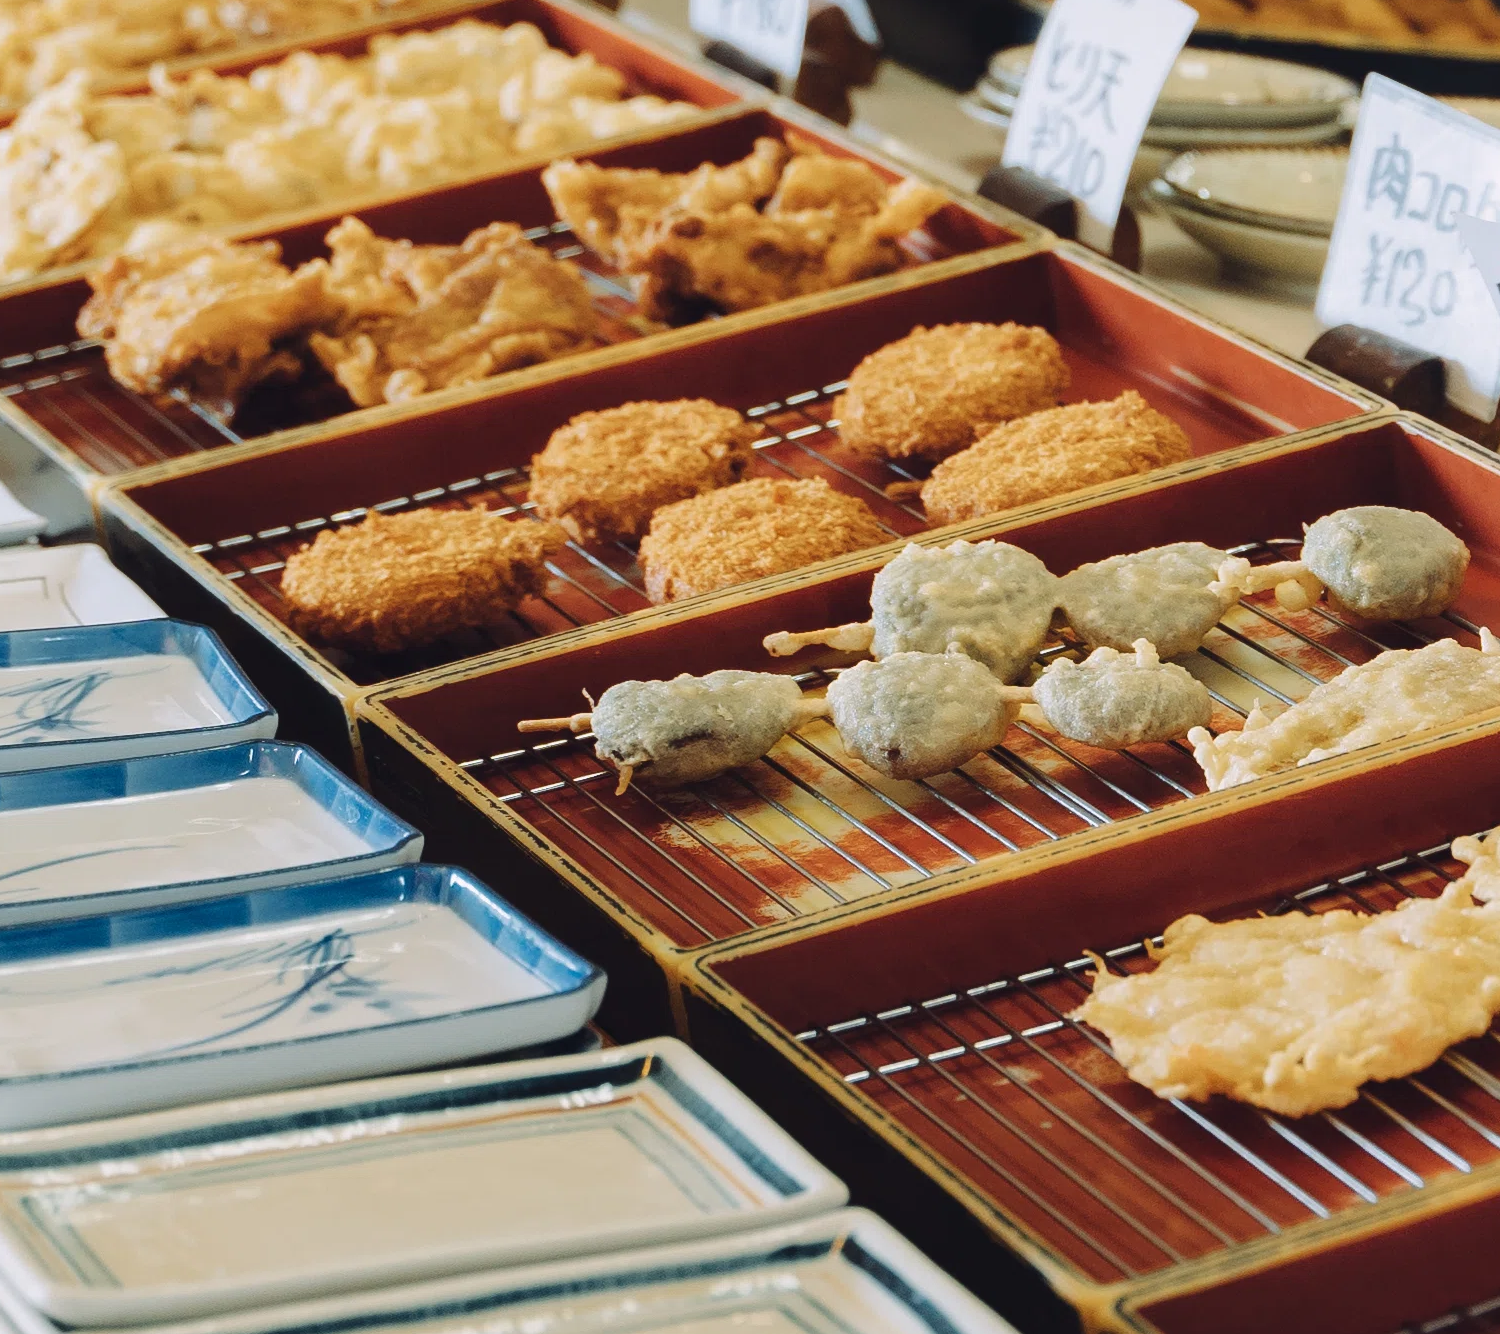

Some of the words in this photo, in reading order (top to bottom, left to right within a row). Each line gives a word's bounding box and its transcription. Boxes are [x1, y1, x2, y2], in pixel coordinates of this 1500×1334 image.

[1045, 23, 1132, 134] とり天
[1361, 234, 1457, 327] ¥120
